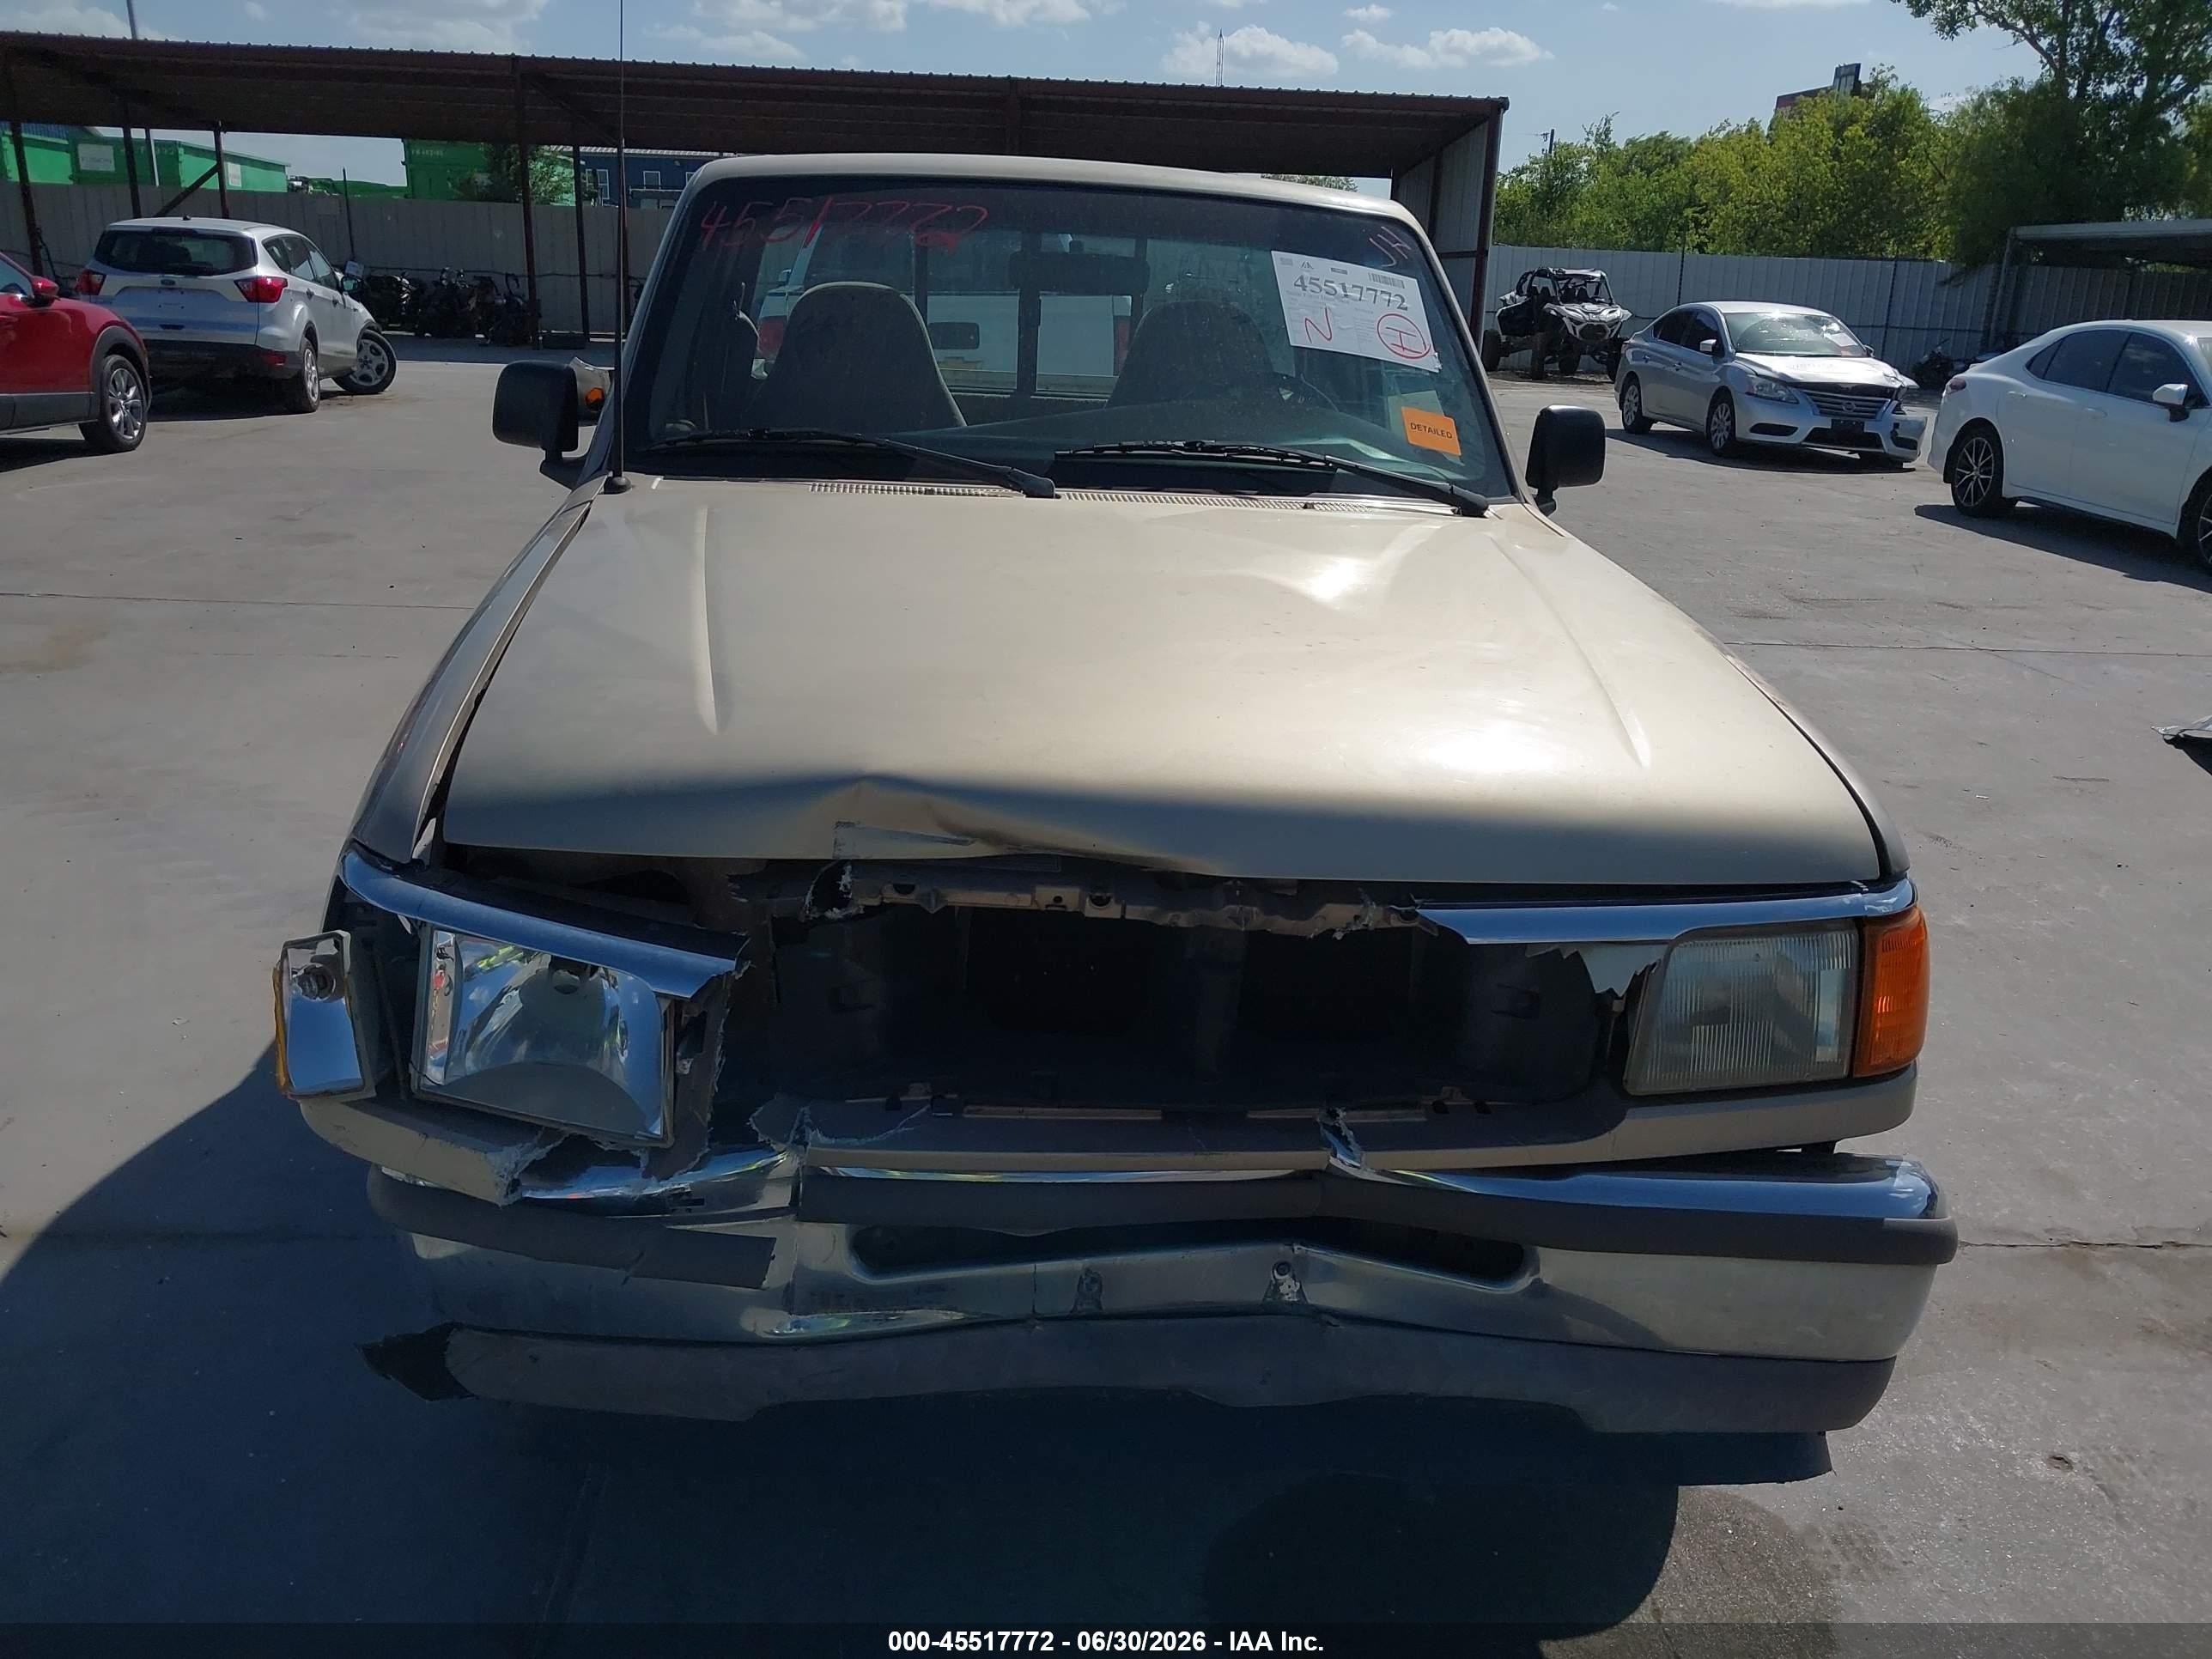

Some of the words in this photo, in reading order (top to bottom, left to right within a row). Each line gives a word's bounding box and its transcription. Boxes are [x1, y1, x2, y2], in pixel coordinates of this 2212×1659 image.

[1293, 274, 1408, 311] 45517772
[1304, 305, 1333, 344] N
[1410, 422, 1453, 439] DETAILED
